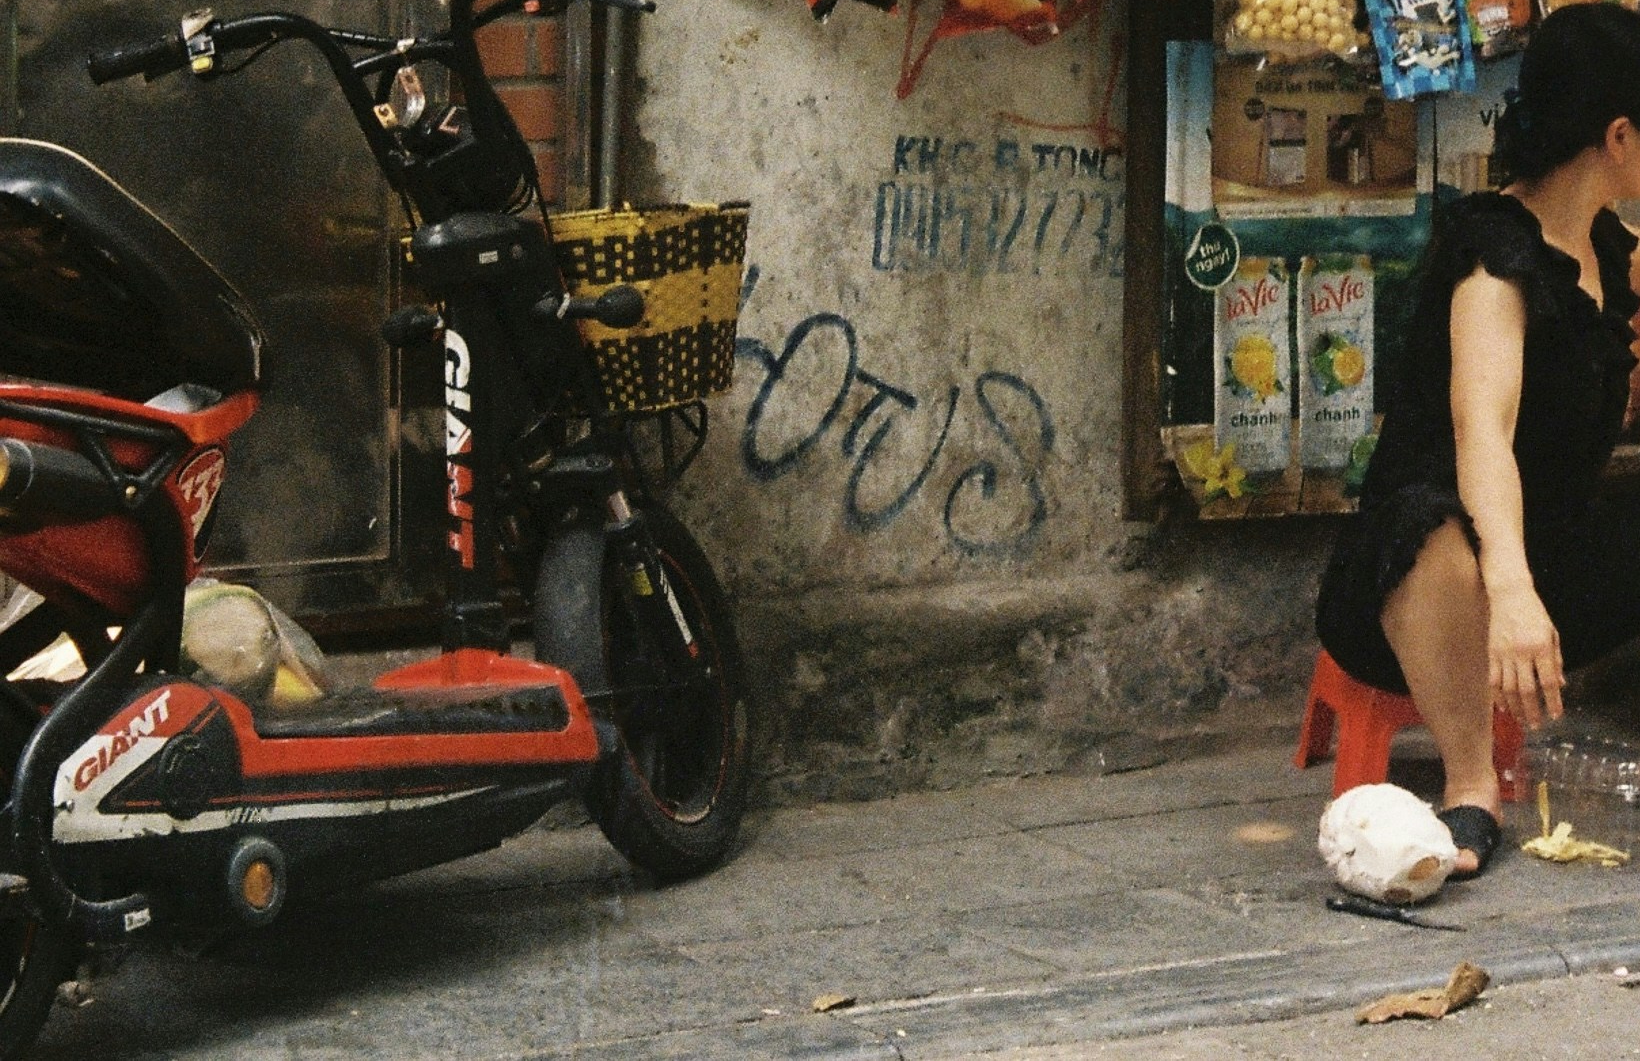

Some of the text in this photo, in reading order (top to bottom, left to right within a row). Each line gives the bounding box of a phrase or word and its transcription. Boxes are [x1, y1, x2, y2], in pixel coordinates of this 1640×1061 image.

[444, 329, 474, 572] GIANT
[1315, 406, 1361, 423] chanh
[73, 689, 172, 793] GIANT
